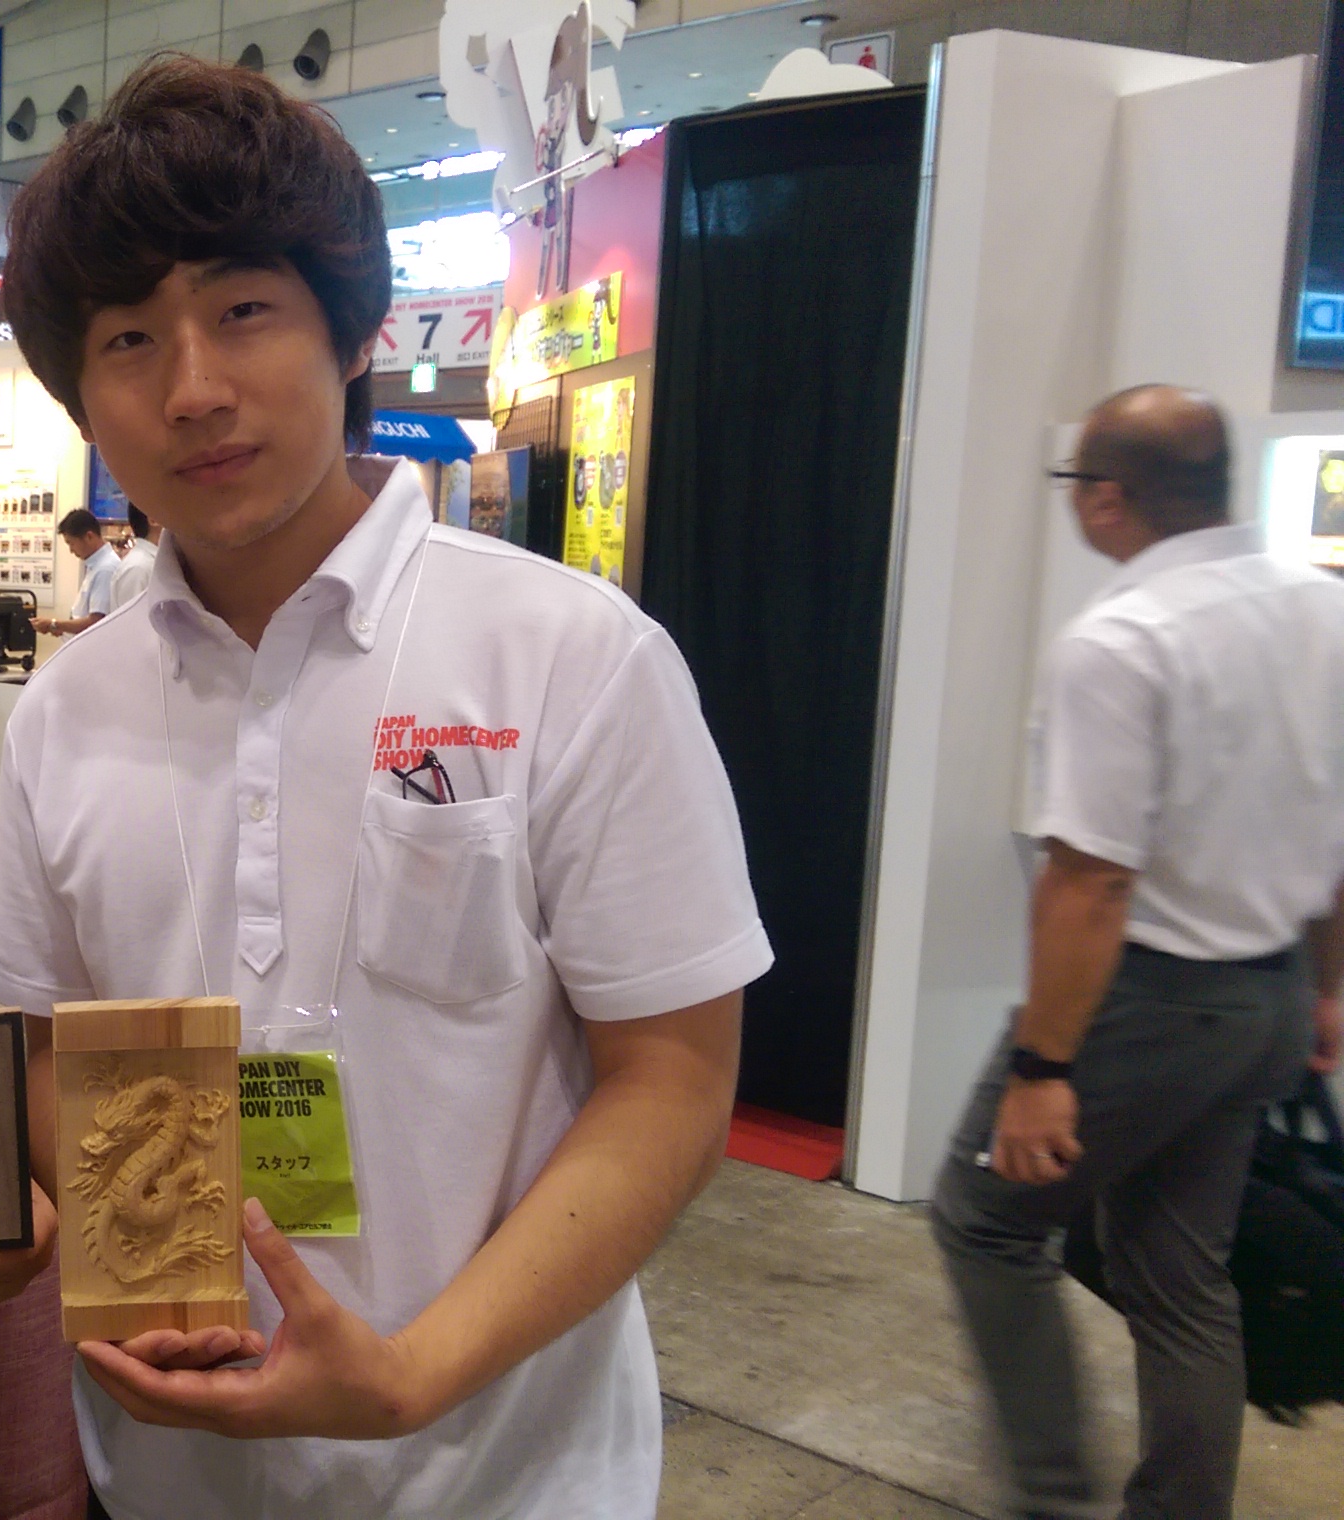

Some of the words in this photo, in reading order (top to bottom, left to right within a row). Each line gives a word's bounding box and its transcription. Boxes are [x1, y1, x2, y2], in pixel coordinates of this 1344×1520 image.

[419, 312, 443, 350] 7
[417, 352, 440, 365] Hall
[371, 420, 431, 438] IGUCHI
[375, 714, 416, 730] JAPAN
[373, 729, 406, 750] DIY
[411, 725, 520, 751] HOMECENTER
[373, 748, 430, 771] SHOW
[239, 1061, 271, 1079] PAN
[273, 1061, 301, 1078] DIY
[239, 1079, 326, 1099] MECENTER
[275, 1099, 312, 1117] 2016
[256, 1155, 312, 1170] スタッフ
